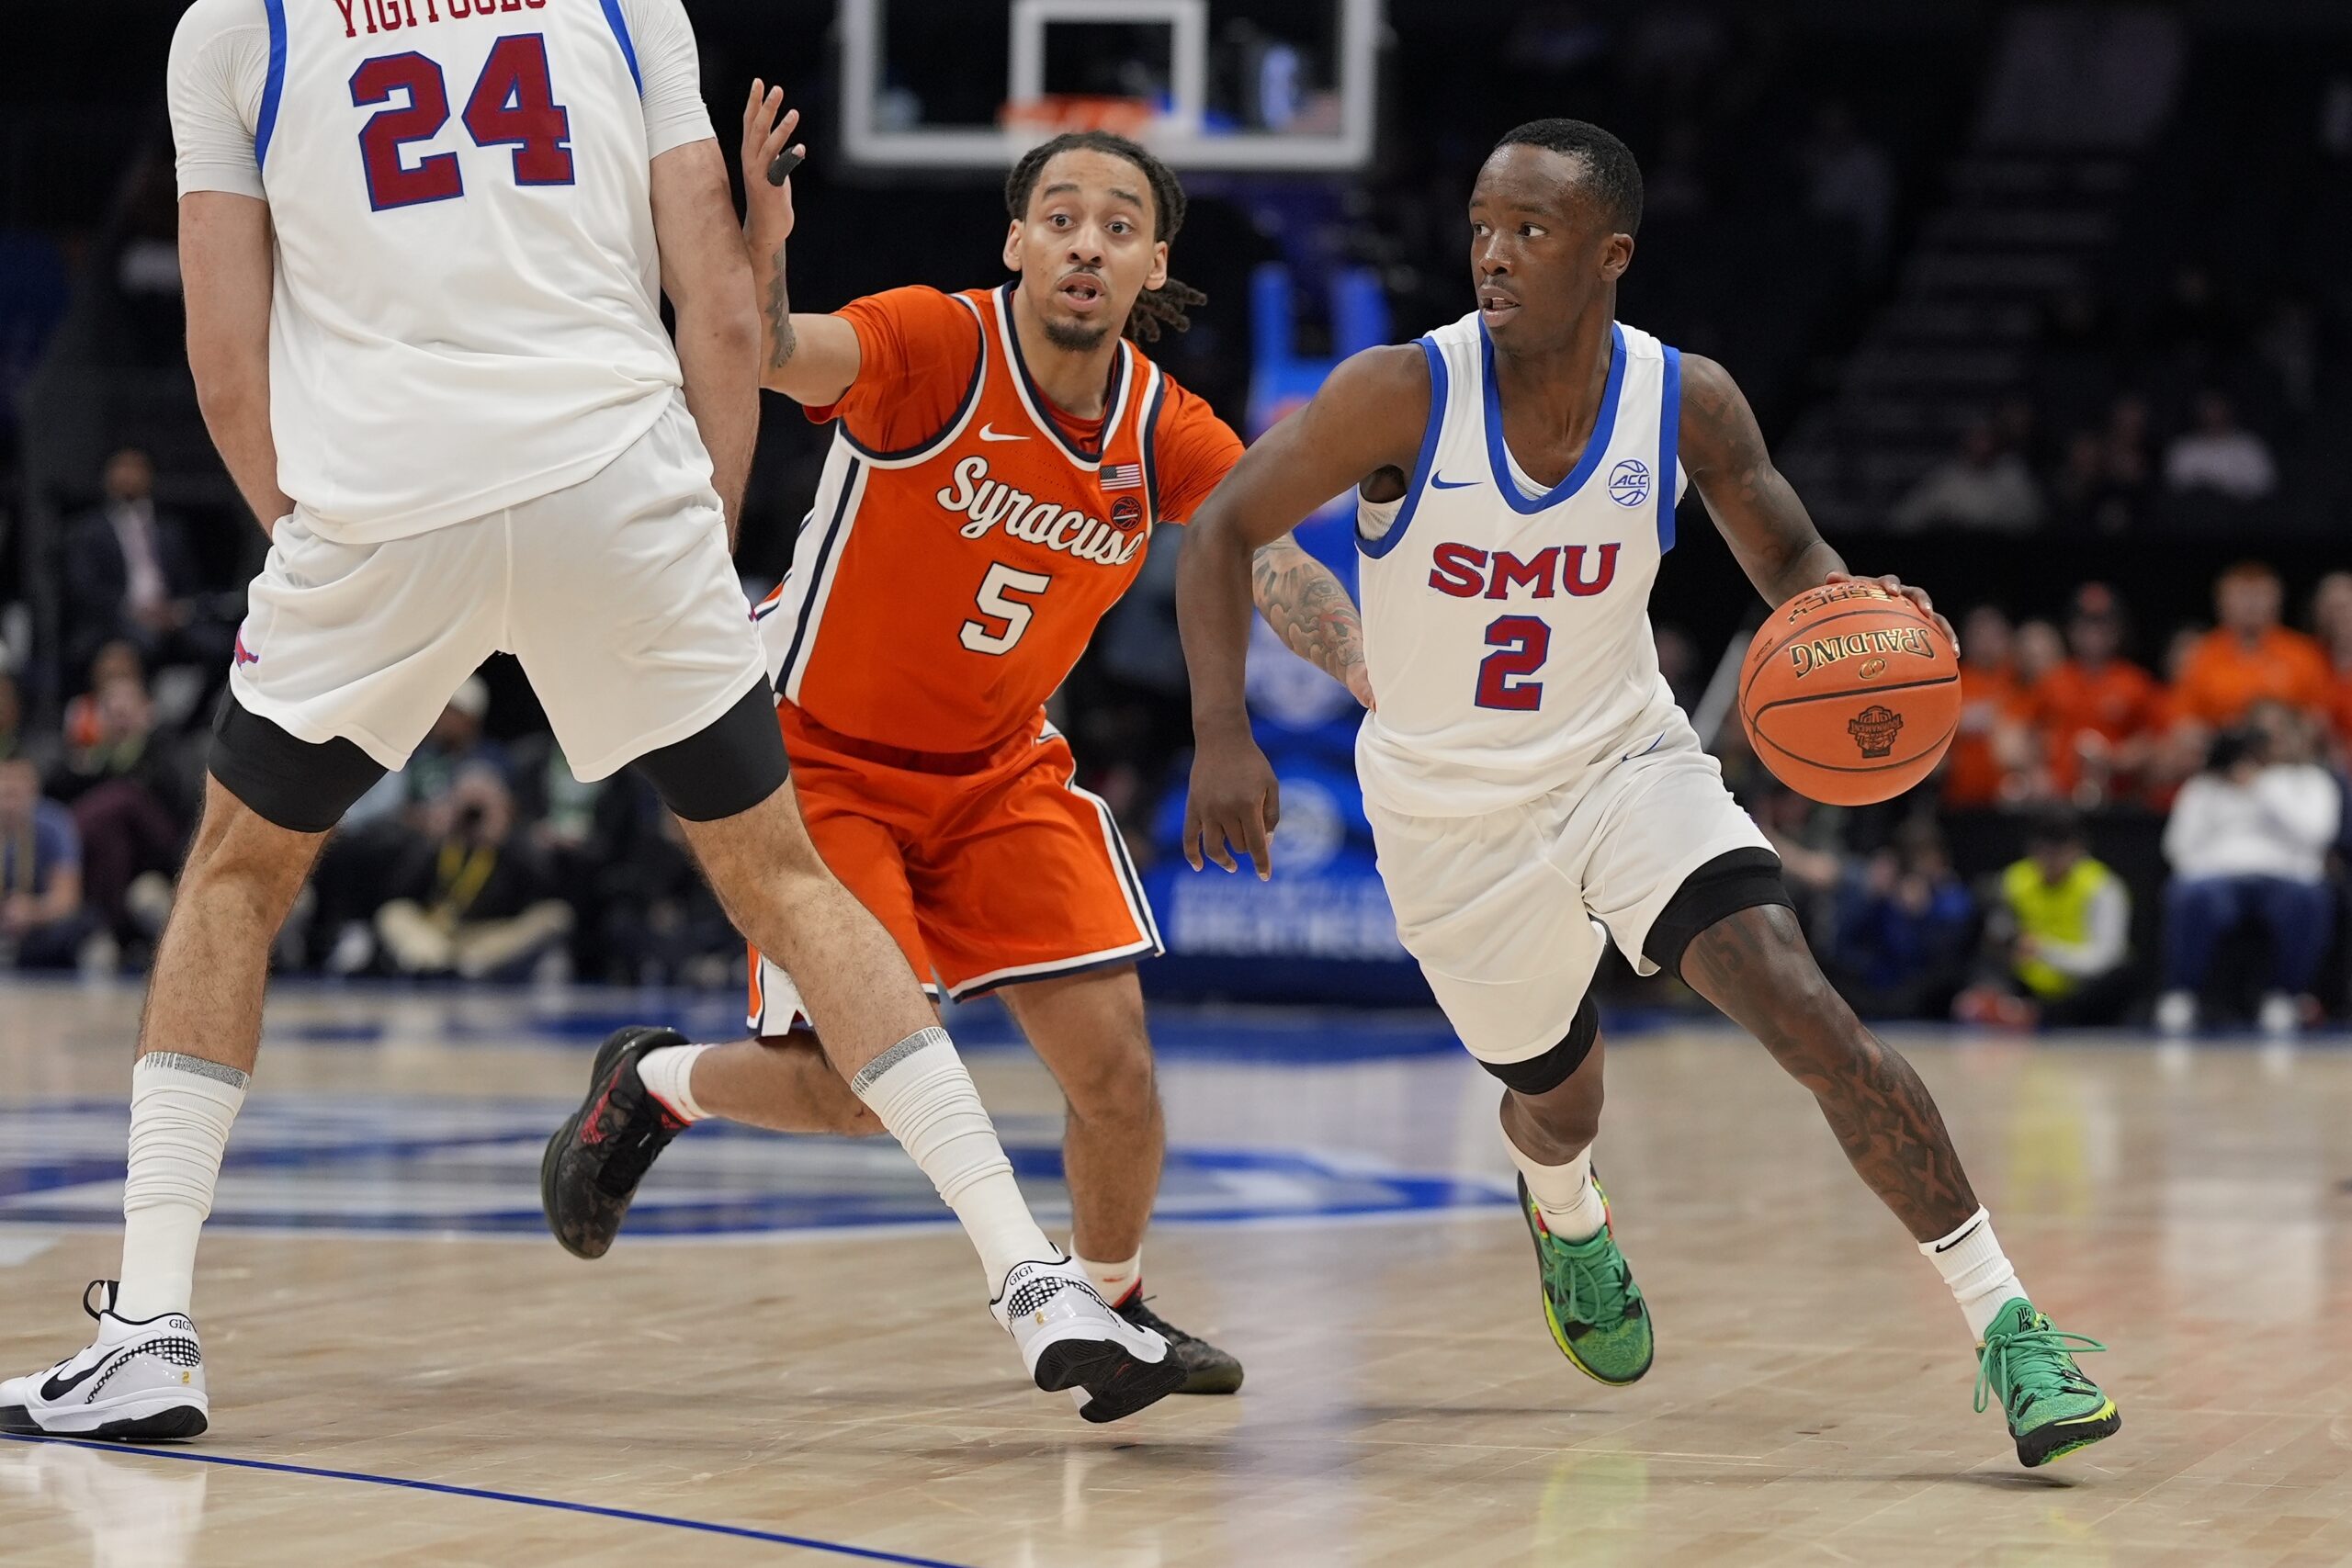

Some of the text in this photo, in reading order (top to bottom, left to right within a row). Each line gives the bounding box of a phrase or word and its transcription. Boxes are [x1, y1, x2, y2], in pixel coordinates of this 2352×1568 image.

[348, 32, 575, 212] 24
[1613, 474, 1650, 486] ACC
[936, 456, 1145, 565] Syracuse
[1428, 542, 1621, 600] SMU
[957, 560, 1052, 656] 5
[1475, 615, 1551, 711] 2
[1790, 627, 1935, 679] SPALDING
[1009, 1265, 1034, 1286] GIGI
[169, 1318, 192, 1332] GIGI
